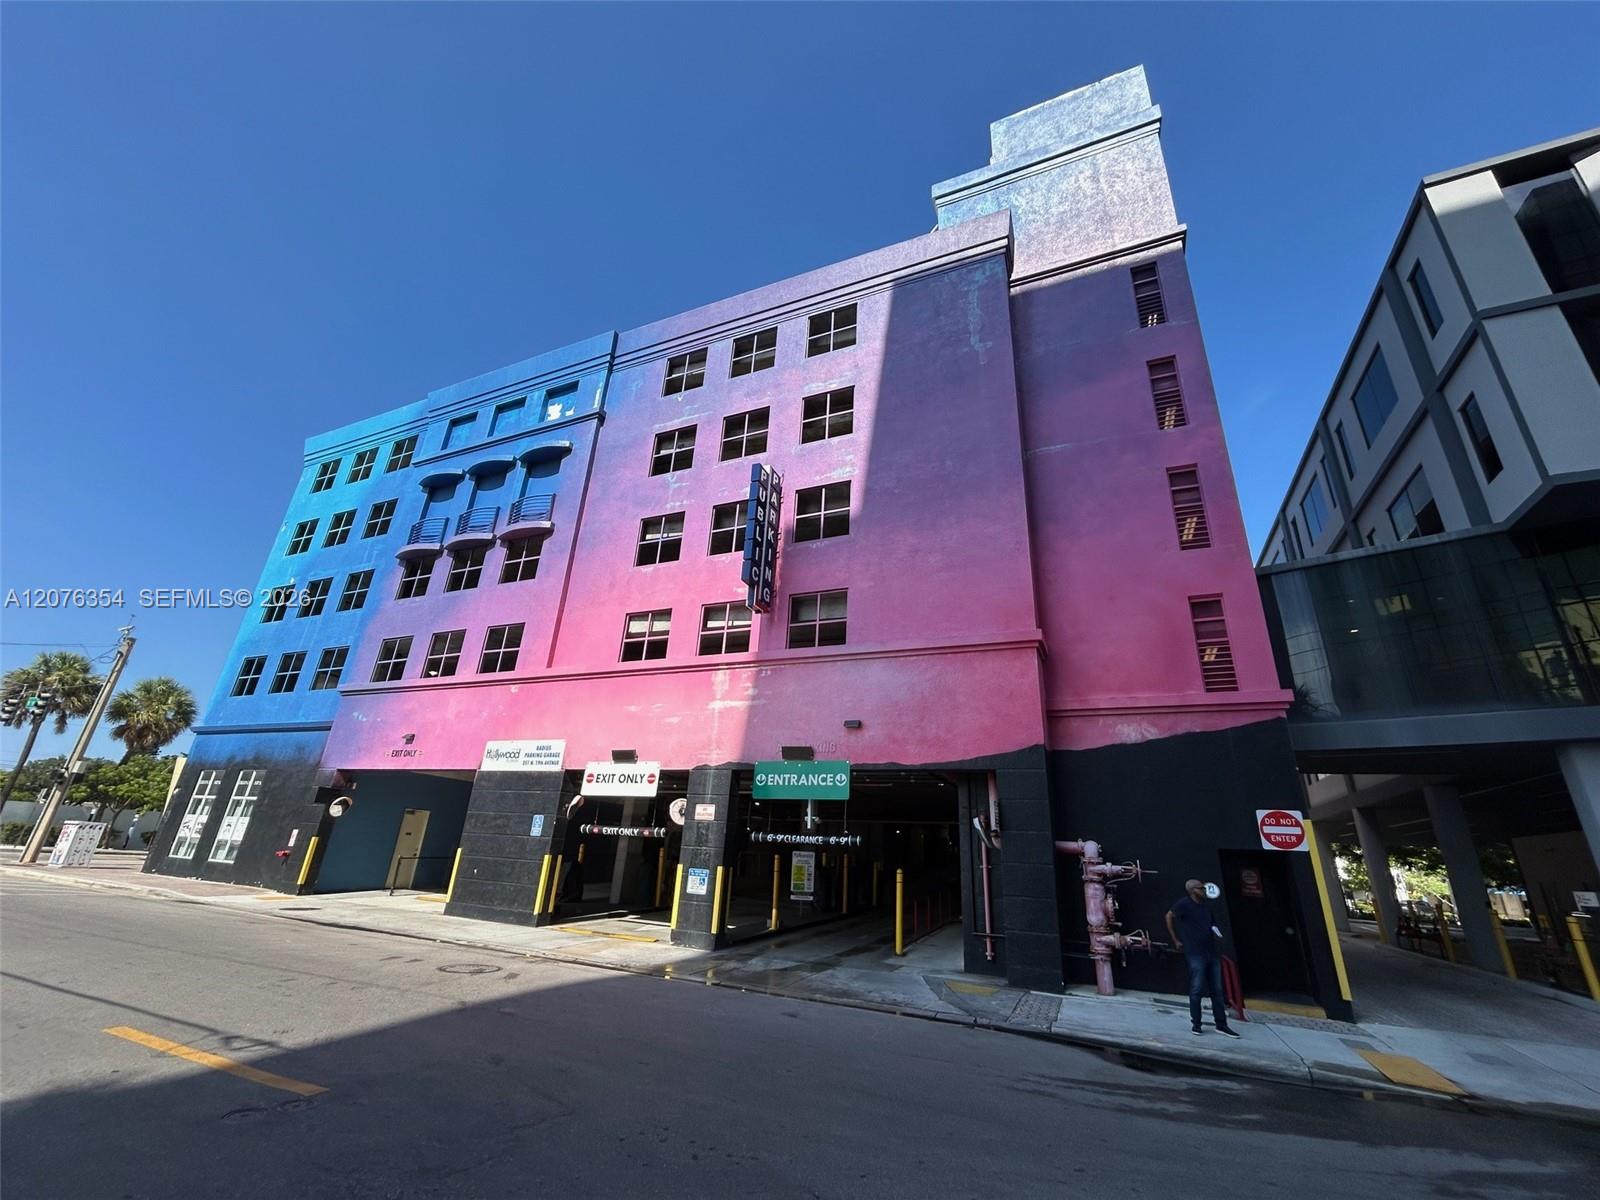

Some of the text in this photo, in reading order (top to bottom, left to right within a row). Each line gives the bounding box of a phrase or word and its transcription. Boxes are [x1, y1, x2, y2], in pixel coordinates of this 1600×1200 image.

[752, 470, 767, 581] PUBLIC
[763, 474, 779, 602] PARKING
[391, 749, 418, 758] EXIT ONLY
[485, 748, 521, 760] Hollywood
[595, 773, 646, 784] EXIT ONLY
[767, 773, 834, 786] ENTRANCE
[602, 827, 640, 837] EXIT ONLY
[784, 834, 823, 845] CLEARANCE
